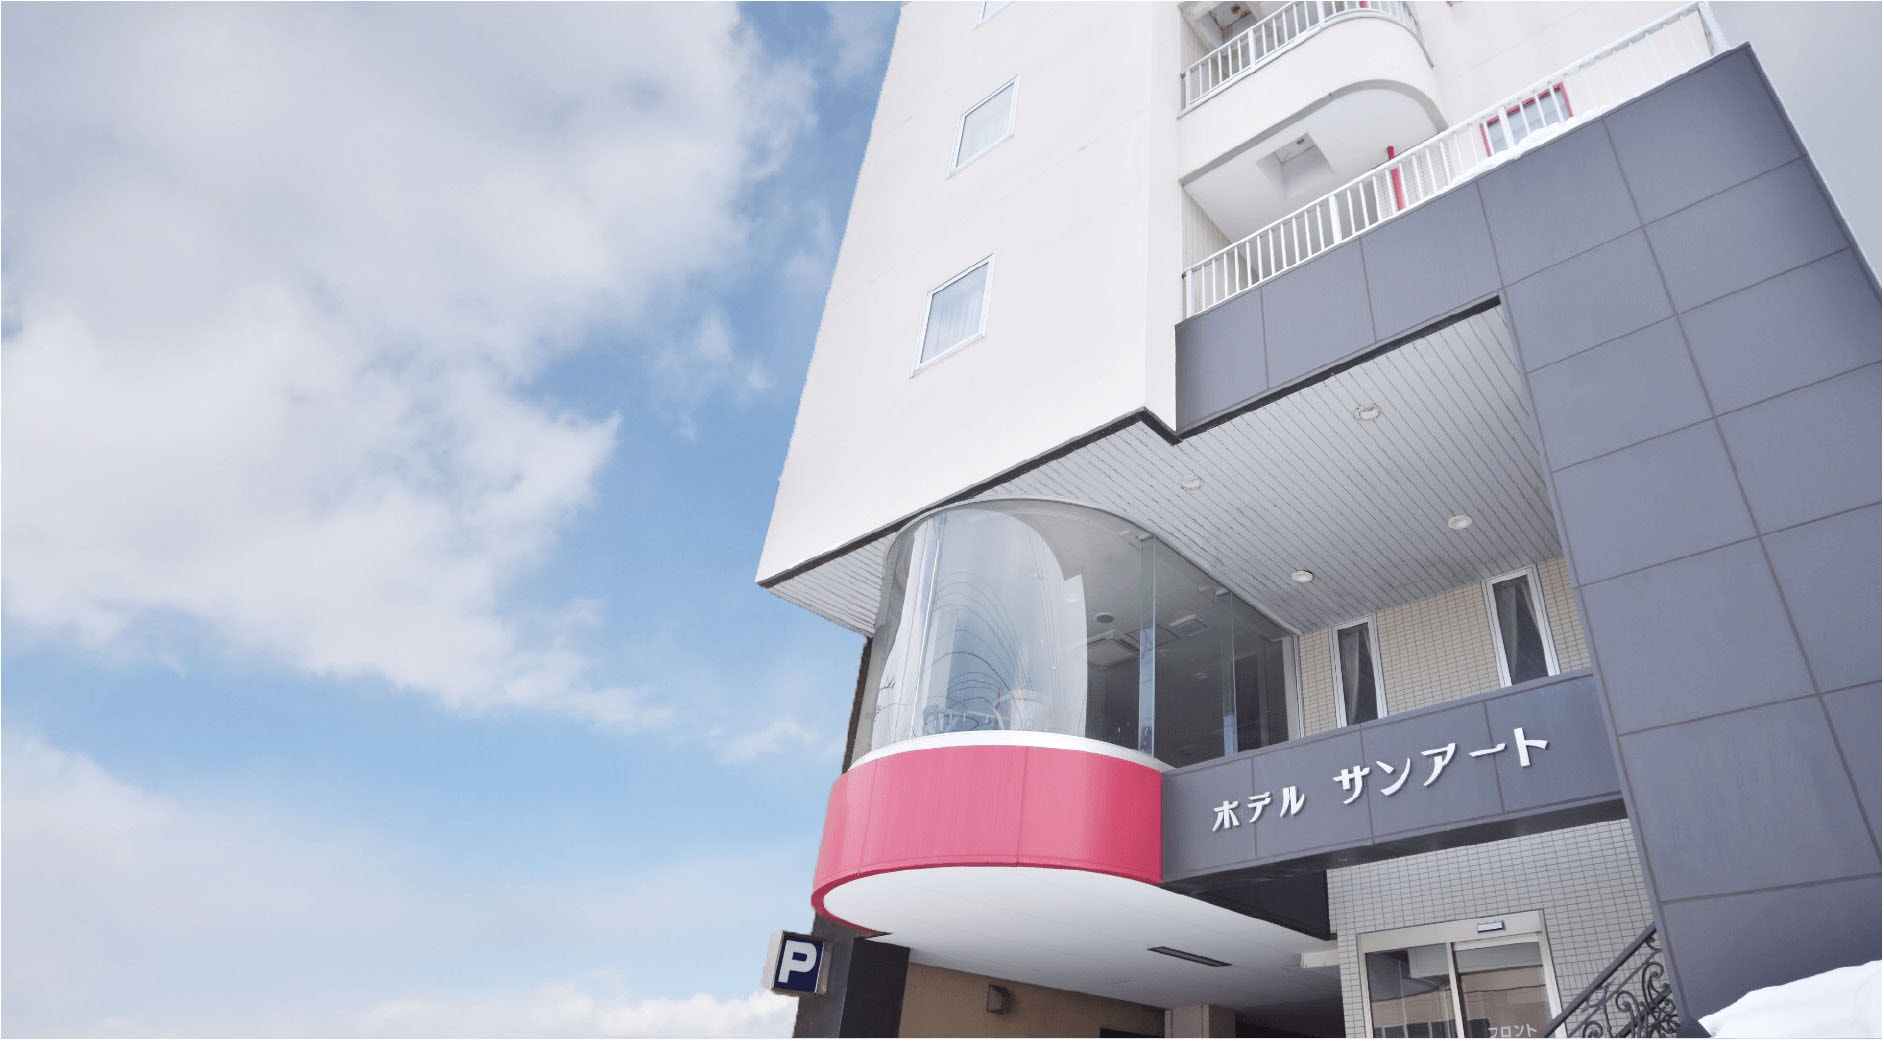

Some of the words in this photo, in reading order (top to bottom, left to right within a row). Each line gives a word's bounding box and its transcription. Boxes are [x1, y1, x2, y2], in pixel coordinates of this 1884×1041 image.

[1212, 785, 1306, 832] ホテル
[1332, 727, 1549, 806] サンアート
[778, 939, 818, 984] P
[1487, 1023, 1538, 1038] フロント
